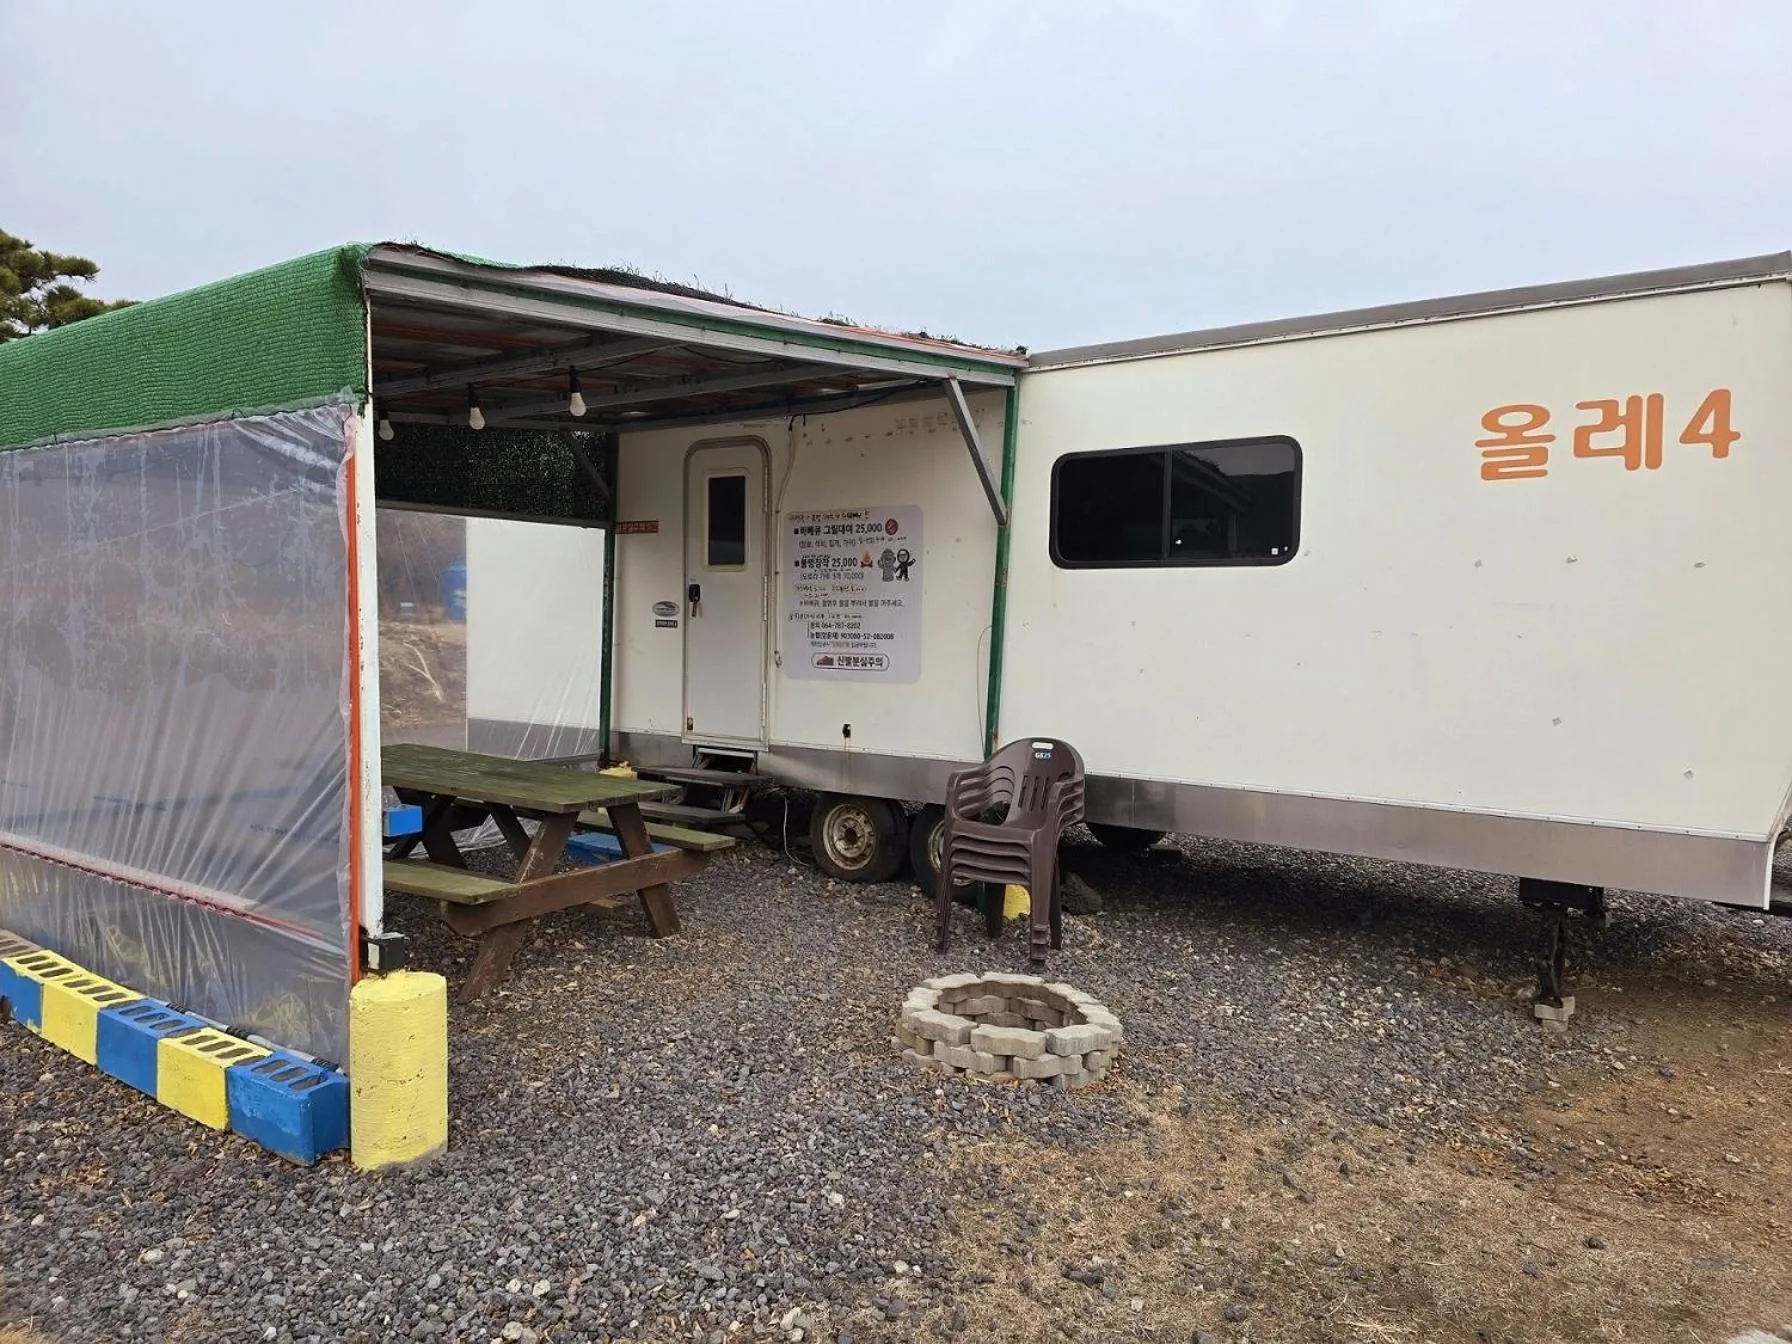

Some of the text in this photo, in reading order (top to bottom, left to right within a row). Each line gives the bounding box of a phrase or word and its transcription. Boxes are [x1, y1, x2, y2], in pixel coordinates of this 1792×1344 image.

[800, 522, 883, 537] 바베큐 그릴대여 25,000
[800, 556, 858, 569] 불멍장작 25,000
[836, 655, 884, 668] 신발분실주의
[1034, 751, 1052, 759] GS25
